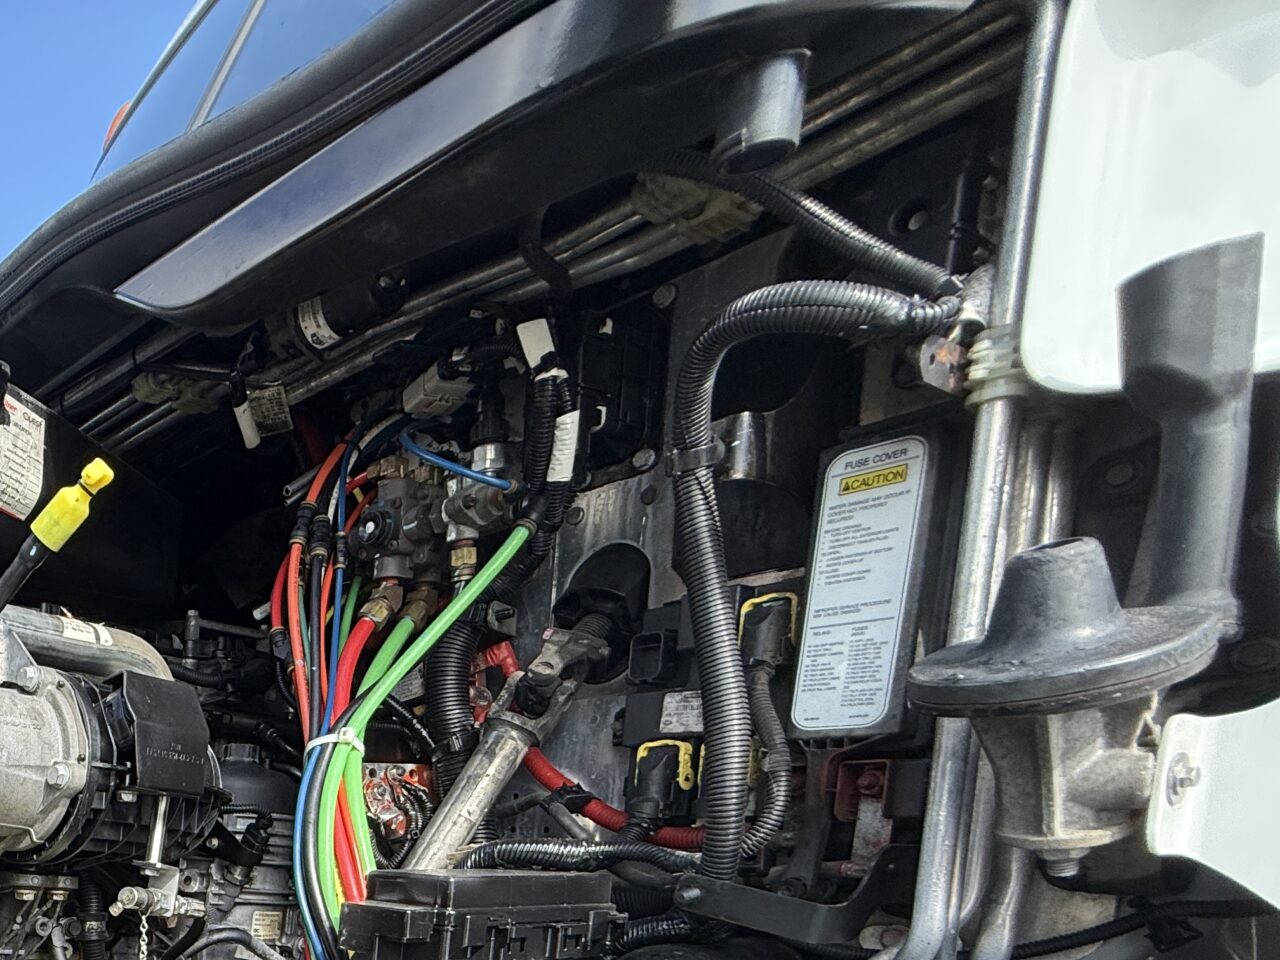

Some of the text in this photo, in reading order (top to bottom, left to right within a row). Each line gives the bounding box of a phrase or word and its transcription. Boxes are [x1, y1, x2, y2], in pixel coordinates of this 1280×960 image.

[844, 447, 907, 471] FUSE COVER
[851, 469, 904, 490] CAUTION
